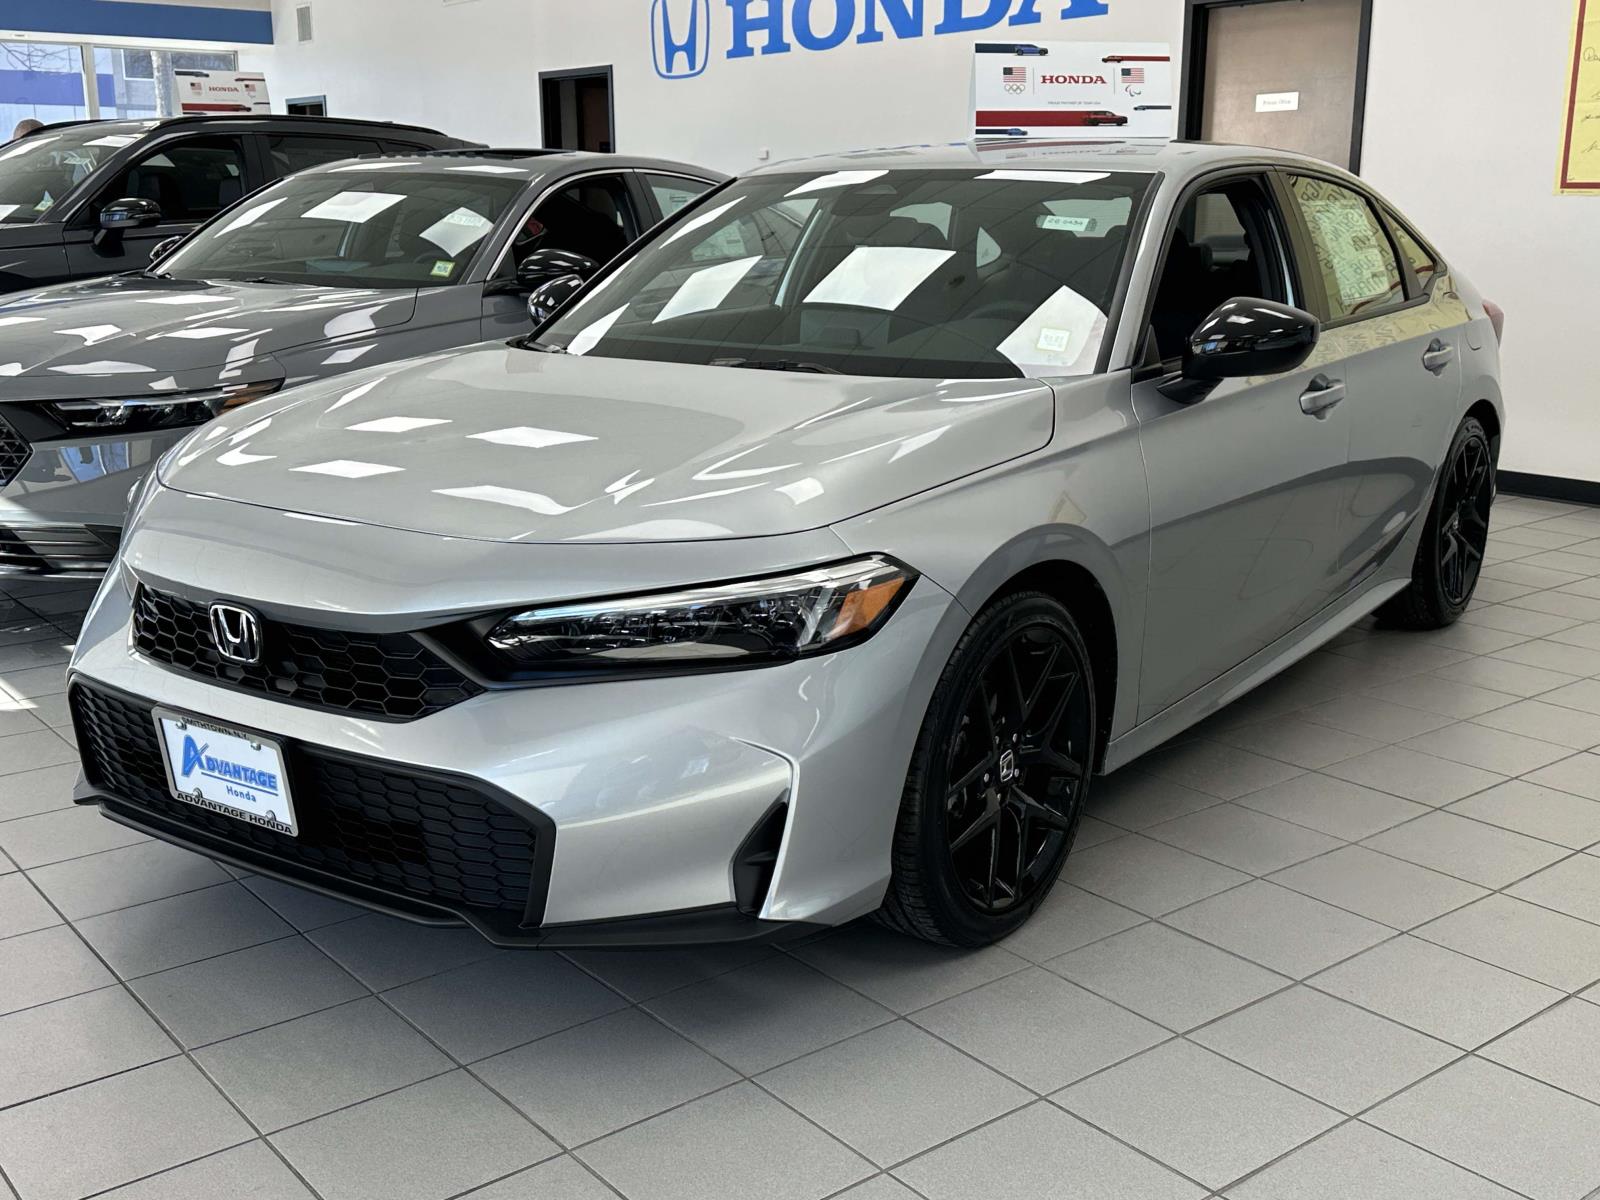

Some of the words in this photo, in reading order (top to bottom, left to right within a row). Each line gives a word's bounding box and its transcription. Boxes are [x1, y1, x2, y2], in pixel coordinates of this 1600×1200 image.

[1041, 75, 1107, 84] HONDA
[181, 734, 279, 791] ADVANTAGE
[225, 784, 257, 803] Honda
[177, 792, 247, 820] ADVANTAGE
[249, 813, 293, 835] HONDA
